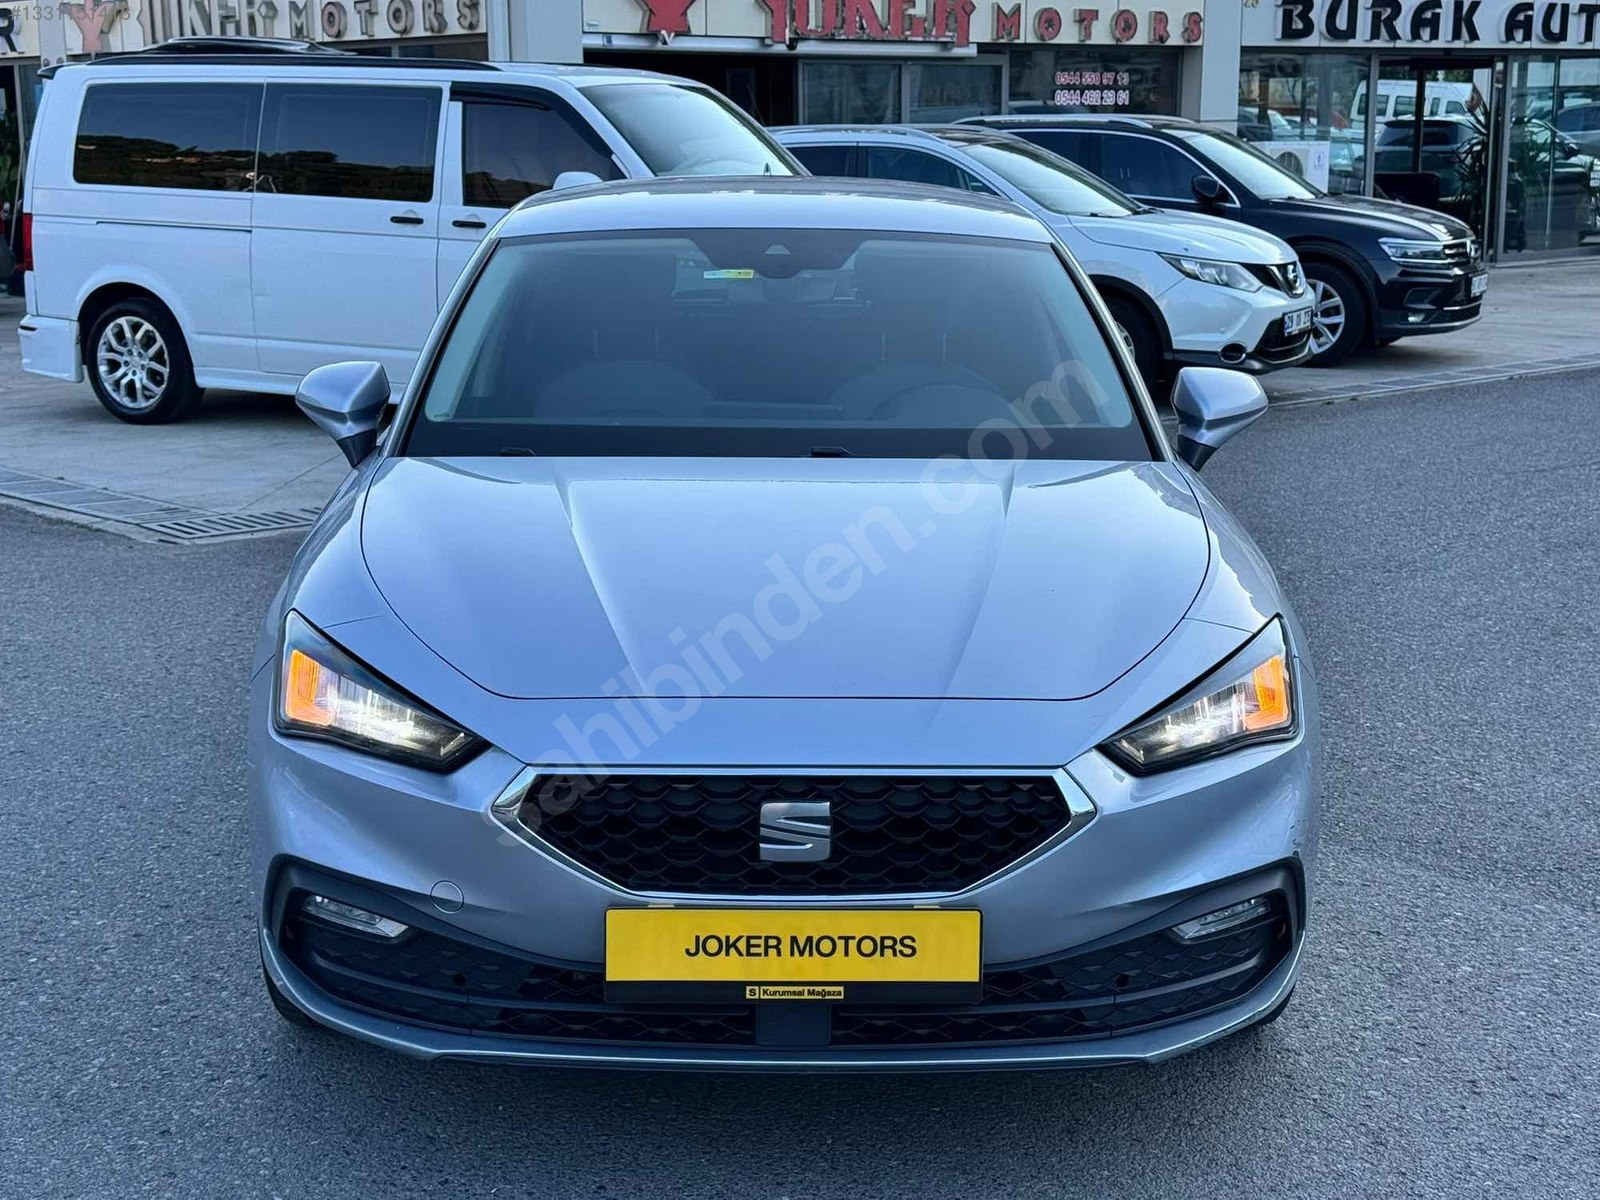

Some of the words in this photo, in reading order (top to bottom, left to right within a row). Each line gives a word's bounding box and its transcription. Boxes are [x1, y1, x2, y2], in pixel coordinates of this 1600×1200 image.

[289, 0, 480, 40] MOTORS
[992, 2, 1203, 43] MOTORS
[1280, 0, 1482, 42] BURAK
[1055, 72, 1080, 85] 0544
[1082, 72, 1101, 85] 550
[1055, 90, 1080, 105] 0544
[1081, 90, 1101, 105] 462
[1117, 90, 1129, 105] 61
[685, 934, 783, 958] JOKER
[789, 934, 918, 958] MOTORS
[748, 987, 757, 997] S
[762, 987, 805, 997] Kurumsal
[806, 987, 842, 998] Mağaza
